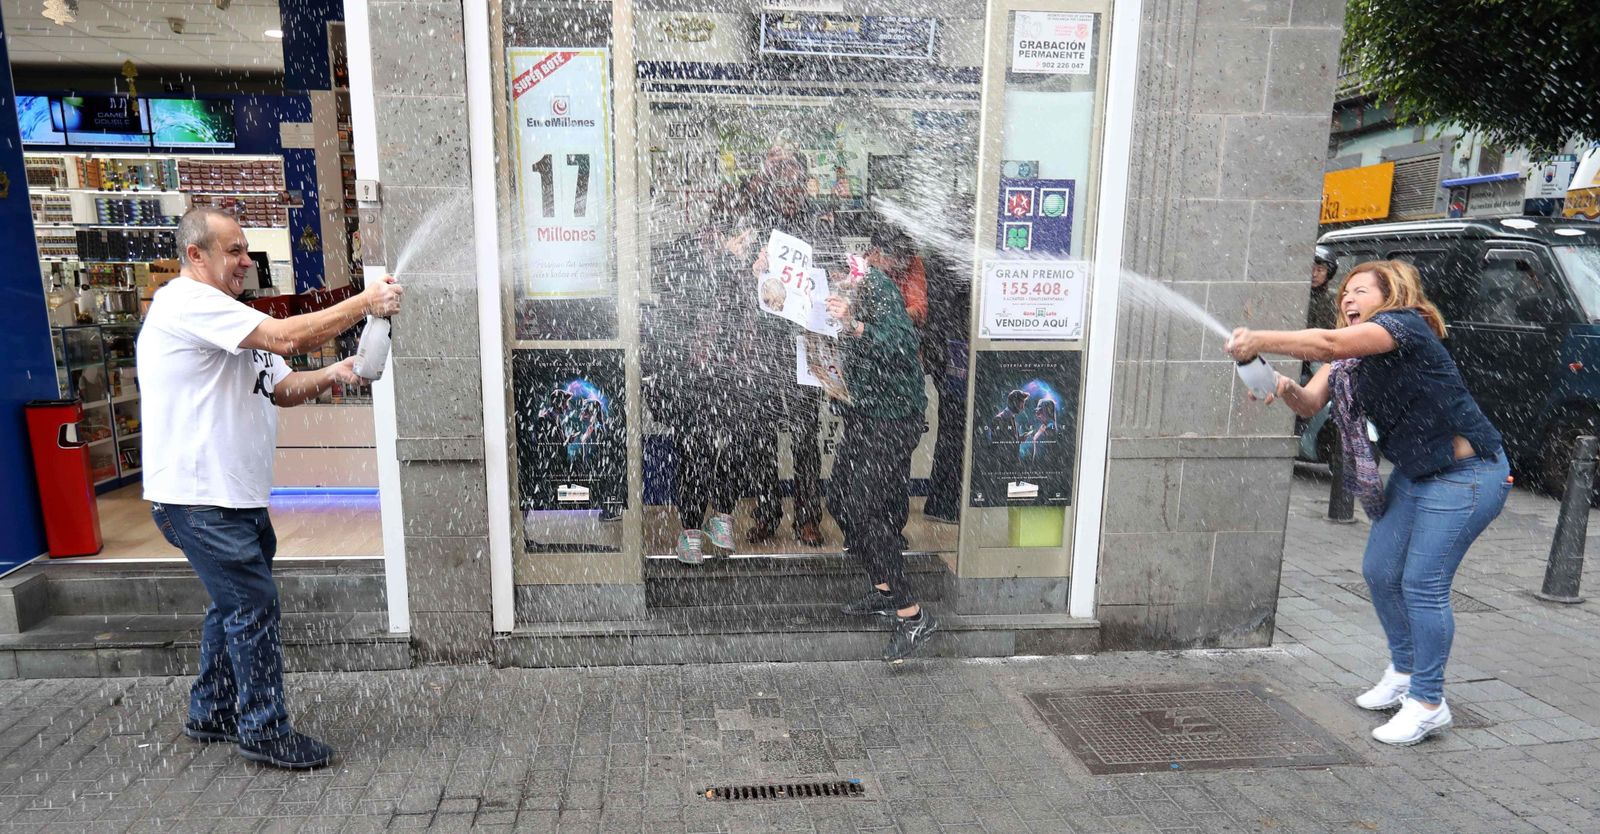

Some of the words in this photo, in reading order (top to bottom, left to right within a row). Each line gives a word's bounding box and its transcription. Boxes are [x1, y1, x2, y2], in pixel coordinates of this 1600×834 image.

[1019, 39, 1086, 50] GRABACIÓN
[1018, 50, 1085, 59] PERMANENTE
[513, 68, 543, 94] SUPER
[540, 55, 565, 75] BOTE
[526, 117, 595, 127] EuoMillones
[532, 153, 591, 218] 17
[537, 227, 596, 242] Millones
[995, 269, 1029, 279] GRAN
[1032, 269, 1075, 279] PREMIO
[995, 319, 1040, 328] VENDIDO
[1042, 317, 1068, 328] AQUÍ
